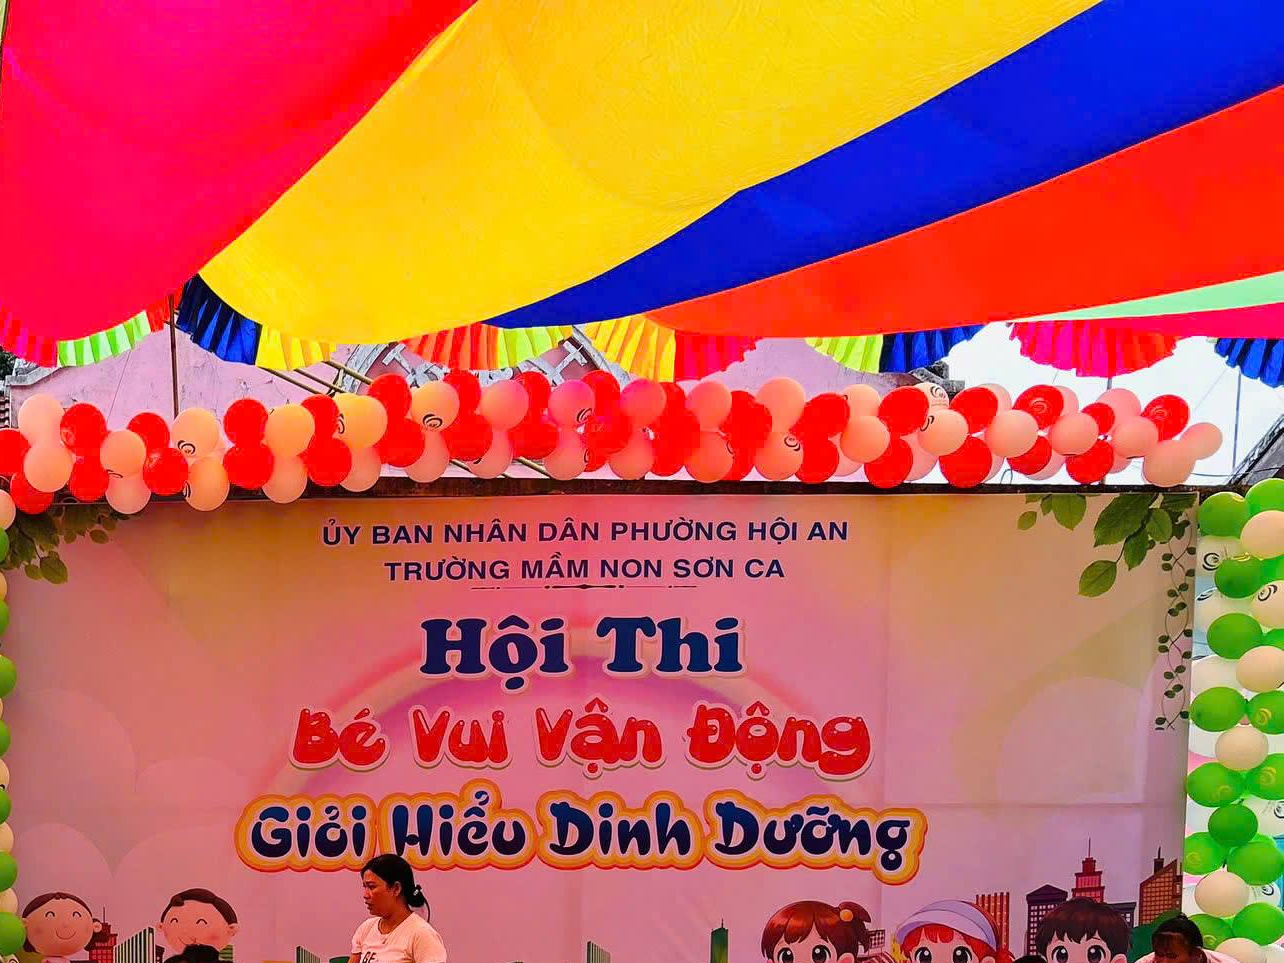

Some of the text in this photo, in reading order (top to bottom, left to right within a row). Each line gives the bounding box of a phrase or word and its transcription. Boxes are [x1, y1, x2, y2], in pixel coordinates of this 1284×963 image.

[322, 516, 849, 547] ỦY BAN NHÂN DÂN PHƯỜNG HỘI AN
[384, 554, 785, 582] TRƯỜNG MẦM NON SƠN CA
[420, 613, 744, 691] Hội Thi
[294, 698, 872, 777] Bé Vui Vận Động
[250, 790, 911, 873] Giải Hiểu Dinh Dưỡng
